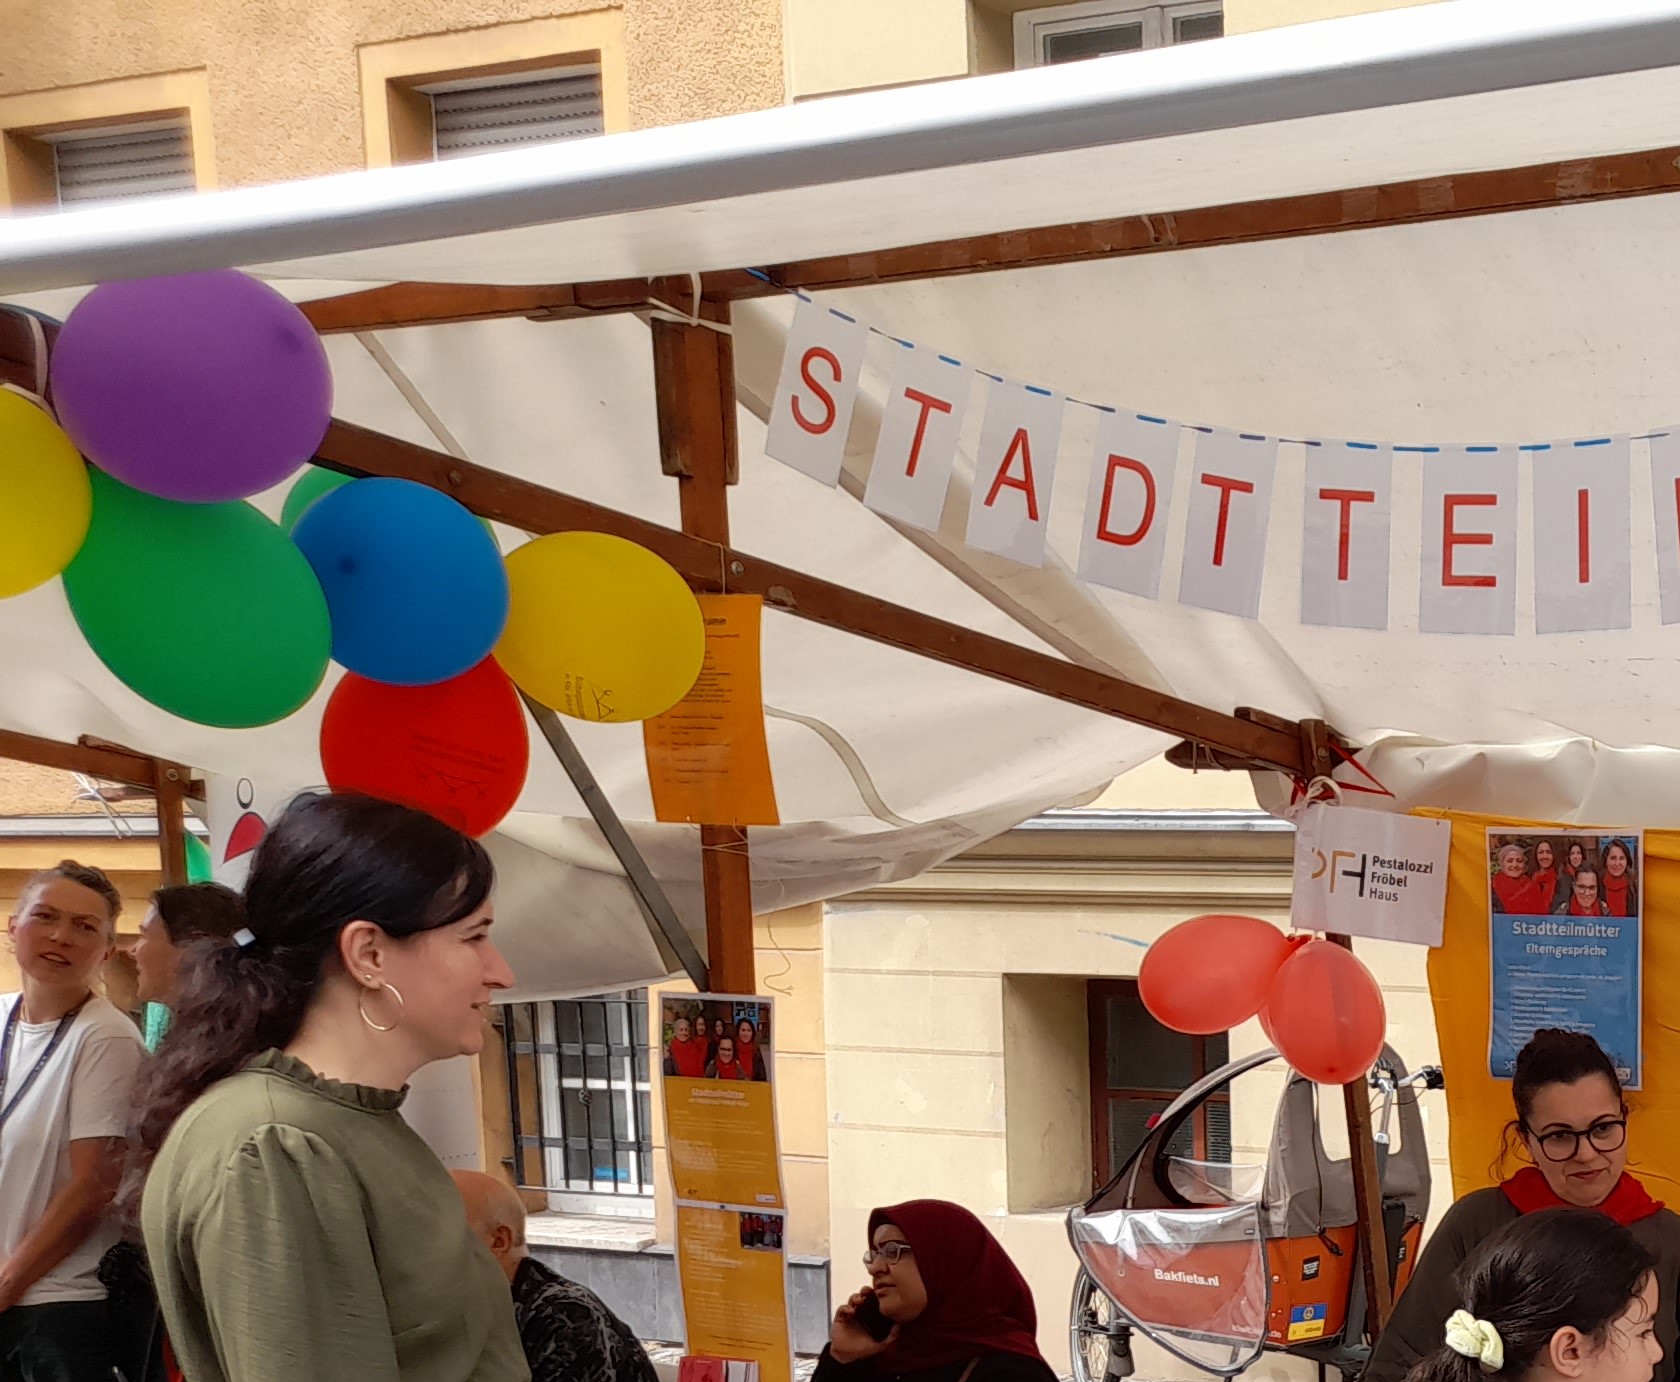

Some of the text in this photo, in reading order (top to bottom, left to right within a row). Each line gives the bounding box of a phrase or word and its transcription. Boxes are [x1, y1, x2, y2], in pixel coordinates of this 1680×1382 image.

[1371, 854, 1434, 875] Pestalozzi
[1370, 871, 1408, 889] Fröbel
[1369, 886, 1399, 902] Haus
[1511, 919, 1621, 939] Stadtteilmütter
[1525, 942, 1608, 959] Elterngespräche
[1154, 1267, 1220, 1287] Bakfiets.nl
